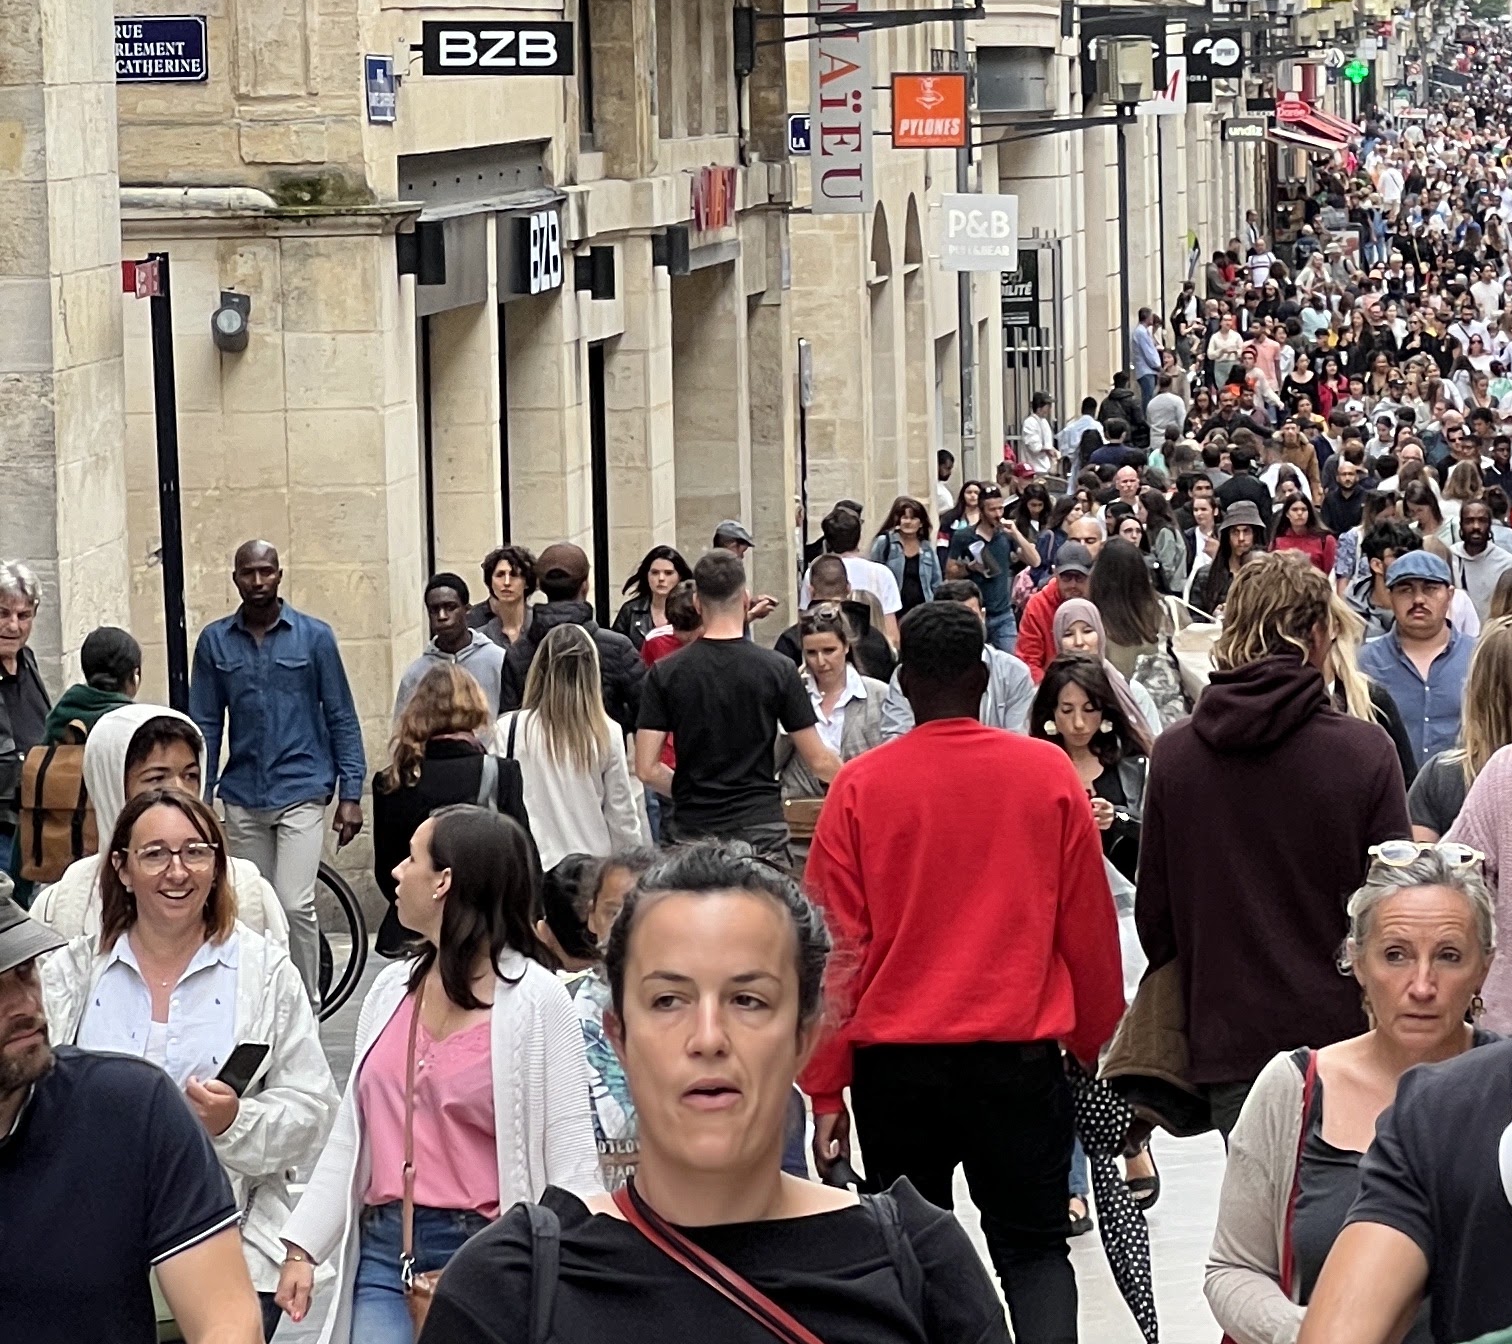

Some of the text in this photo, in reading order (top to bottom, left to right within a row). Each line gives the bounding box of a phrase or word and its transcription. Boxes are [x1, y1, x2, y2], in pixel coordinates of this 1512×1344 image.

[114, 24, 143, 39] RUE
[439, 30, 558, 67] BZB
[116, 58, 201, 76] CATHERINE
[898, 118, 961, 136] PYLONES
[792, 137, 806, 148] LA
[949, 209, 1010, 238] P&B
[530, 210, 561, 294] BZB
